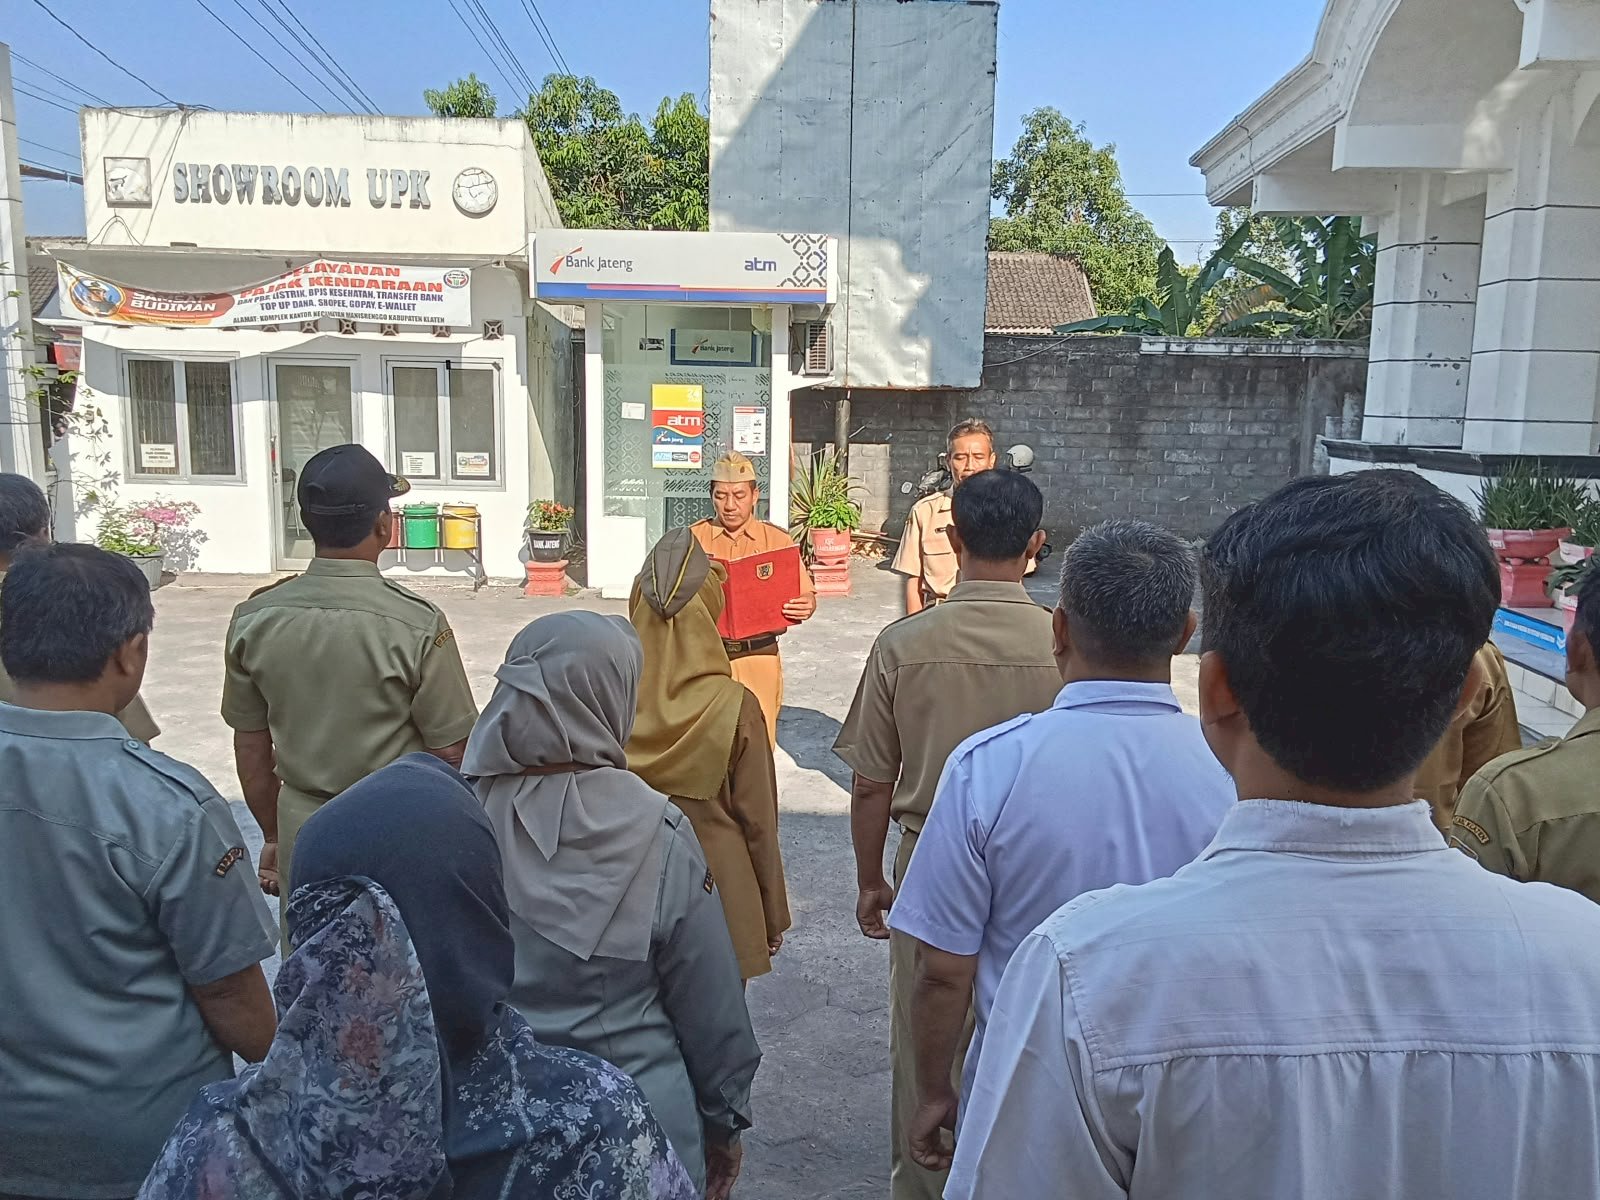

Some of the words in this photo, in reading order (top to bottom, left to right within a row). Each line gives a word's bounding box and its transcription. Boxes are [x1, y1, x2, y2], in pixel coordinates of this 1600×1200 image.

[173, 162, 351, 208] SHOWROOM
[366, 167, 431, 210] UPK
[565, 255, 595, 268] Bank
[597, 256, 633, 272] Jateng
[744, 257, 777, 272] atm
[308, 276, 443, 292] KENDARAAN
[308, 287, 328, 297] BPJS
[376, 291, 419, 301] TRANSFER
[420, 293, 444, 302] BANK
[130, 300, 217, 312] BUDIMAN
[260, 302, 277, 311] TOP
[279, 300, 291, 310] UP
[378, 301, 416, 311] E-WALLET
[260, 313, 288, 321] KOMPLEK
[289, 311, 312, 319] KANTOR
[667, 415, 701, 426] atm
